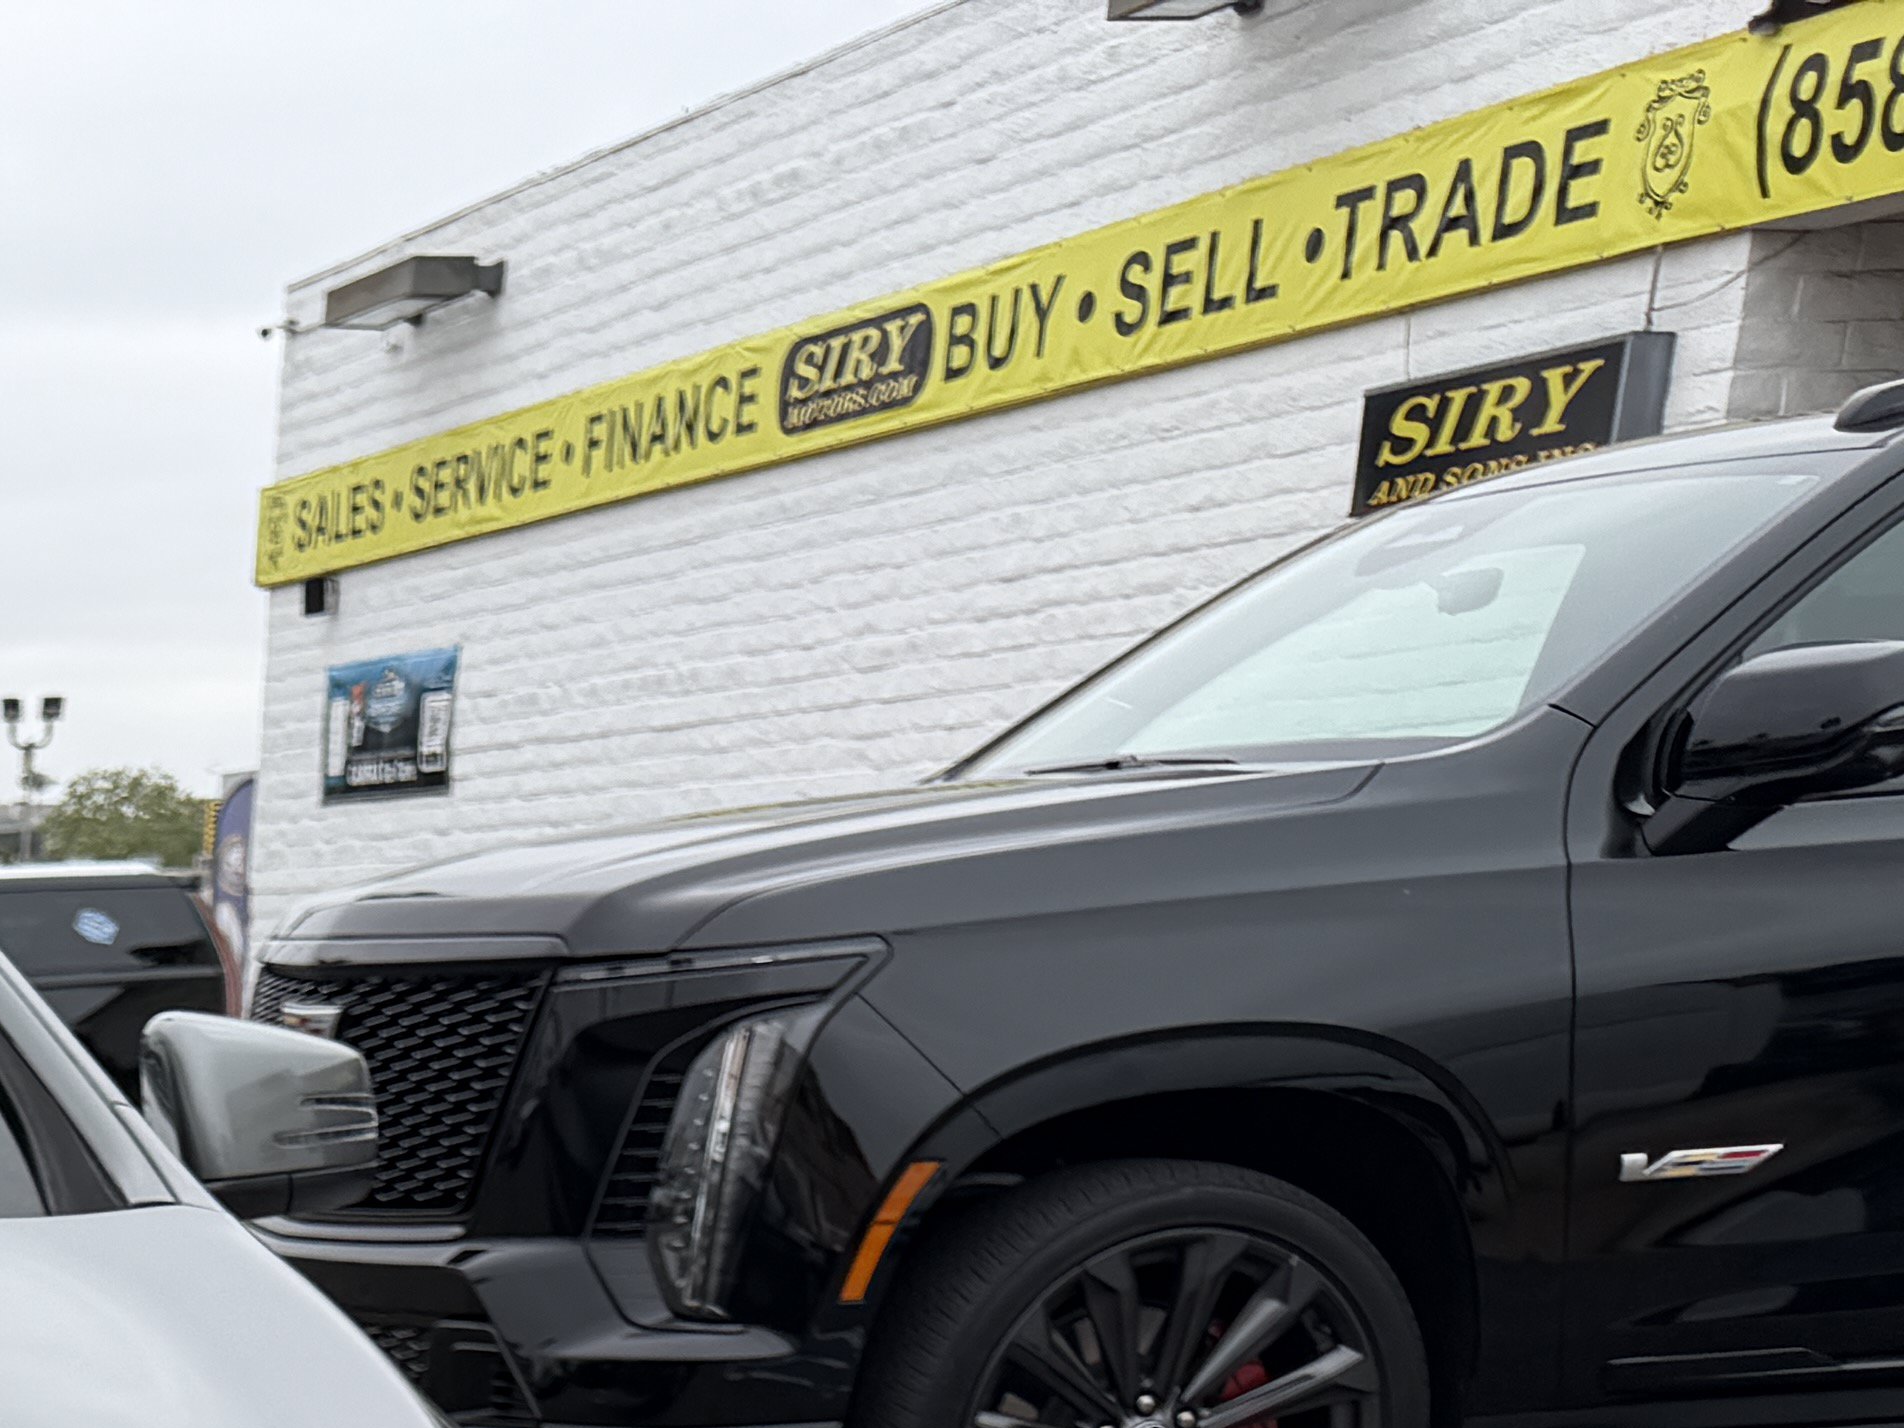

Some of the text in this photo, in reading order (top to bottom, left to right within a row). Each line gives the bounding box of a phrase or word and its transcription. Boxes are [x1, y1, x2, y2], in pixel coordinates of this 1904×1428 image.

[944, 117, 1612, 383] BUY SELL TRADE
[784, 373, 919, 428] MOTORS.COM
[785, 312, 927, 402] SIRY
[293, 365, 762, 552] SALES SERVICE FINANCE
[1375, 358, 1605, 468] SIRY
[1367, 471, 1437, 506] AND
